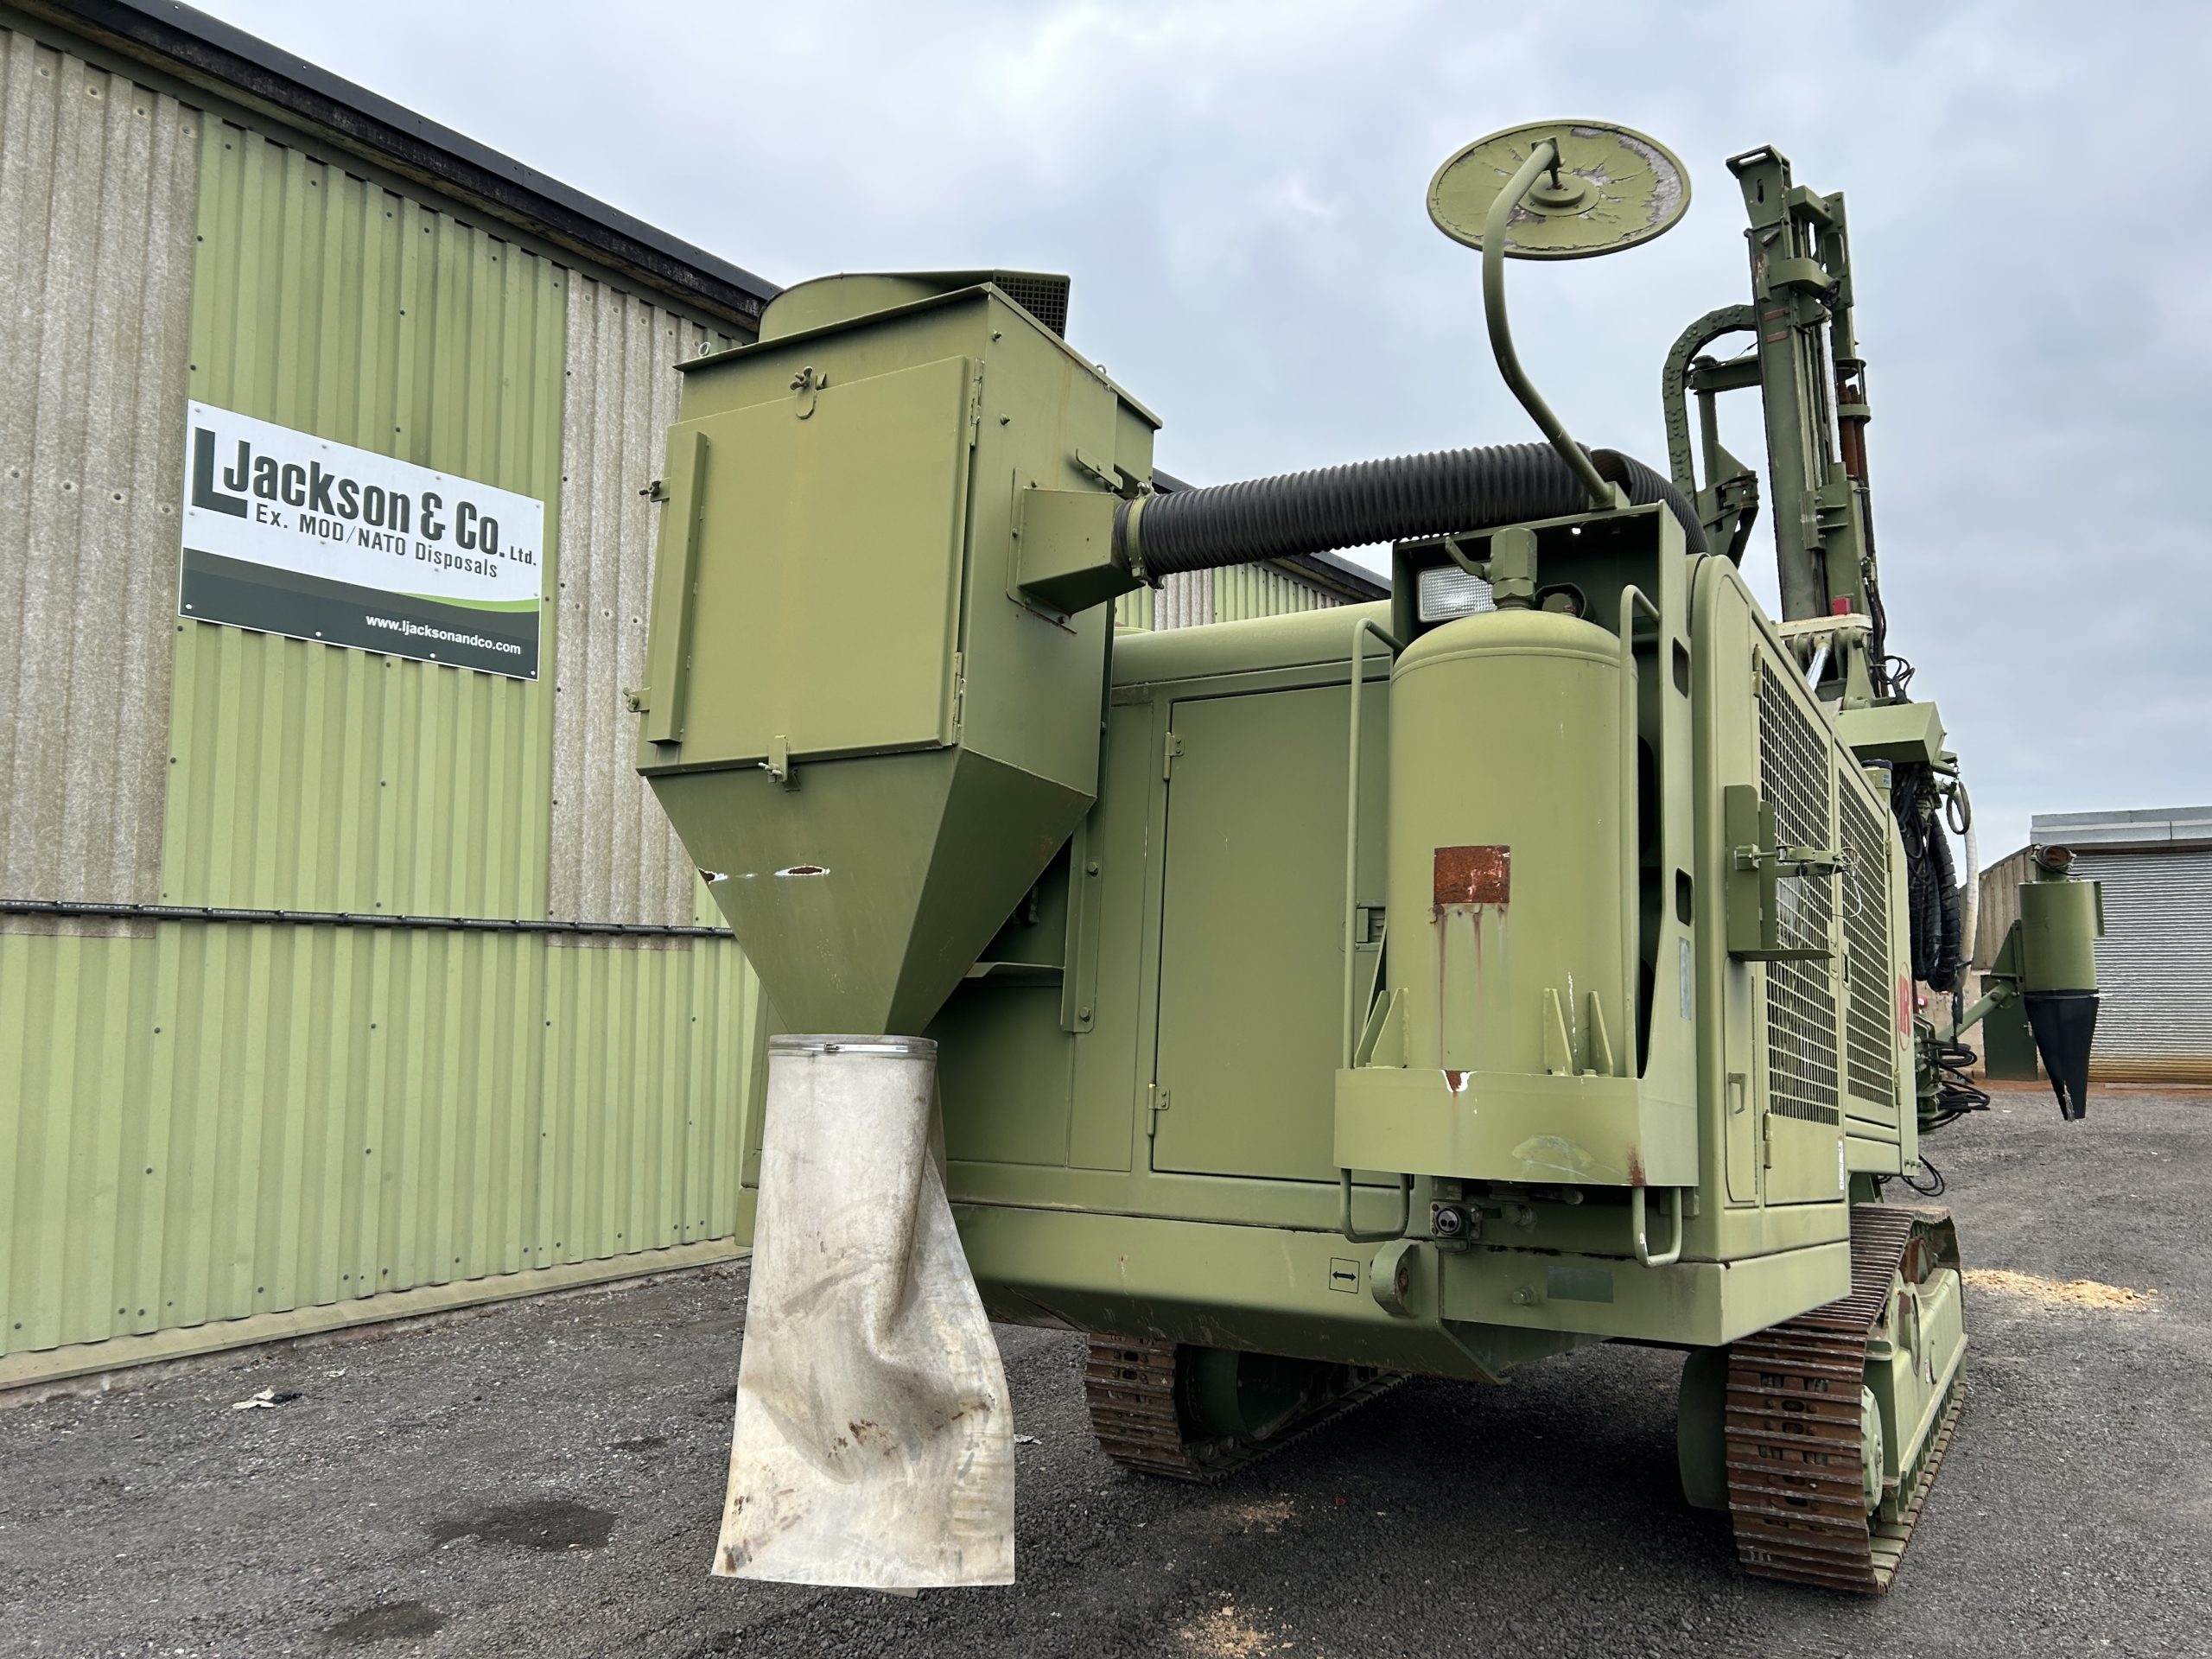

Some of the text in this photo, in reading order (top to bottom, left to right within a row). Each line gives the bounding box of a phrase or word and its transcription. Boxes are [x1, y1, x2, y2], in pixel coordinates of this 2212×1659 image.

[256, 503, 498, 578] Ex. MOD/NATO Disposals
[420, 491, 446, 541] &
[455, 500, 505, 558] Co.
[510, 545, 537, 566] Ltd.
[365, 615, 521, 655] www.ljacksonandco.com
